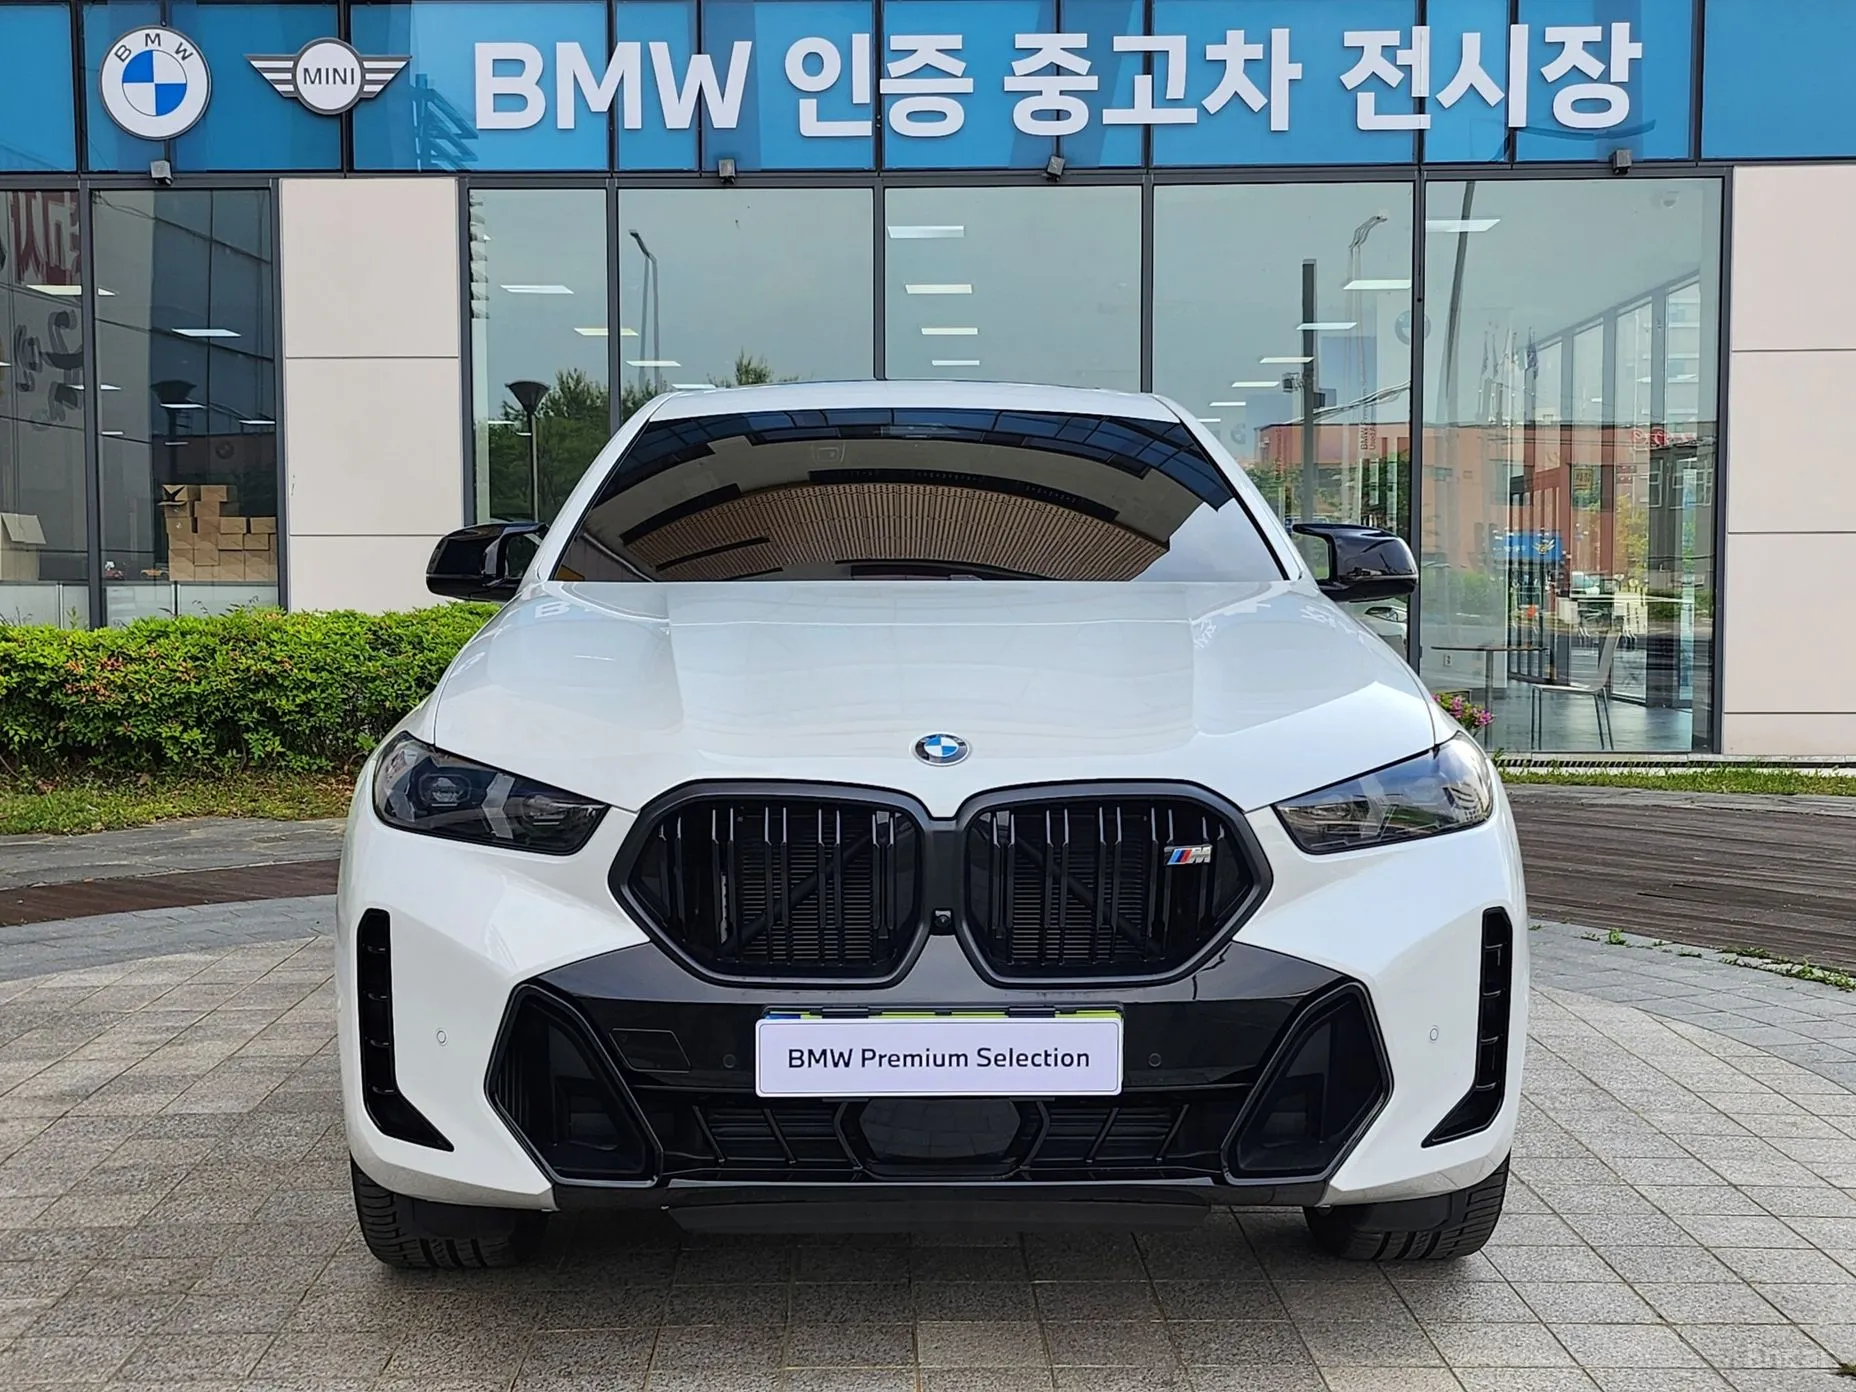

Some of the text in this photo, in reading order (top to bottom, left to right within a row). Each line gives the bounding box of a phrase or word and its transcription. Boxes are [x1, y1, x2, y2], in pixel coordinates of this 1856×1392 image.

[114, 33, 194, 63] BMW
[303, 67, 355, 85] MINI
[474, 22, 1643, 138] BMW 인증 중고차 전시장
[788, 1047, 1090, 1069] BMW Premium Selection
